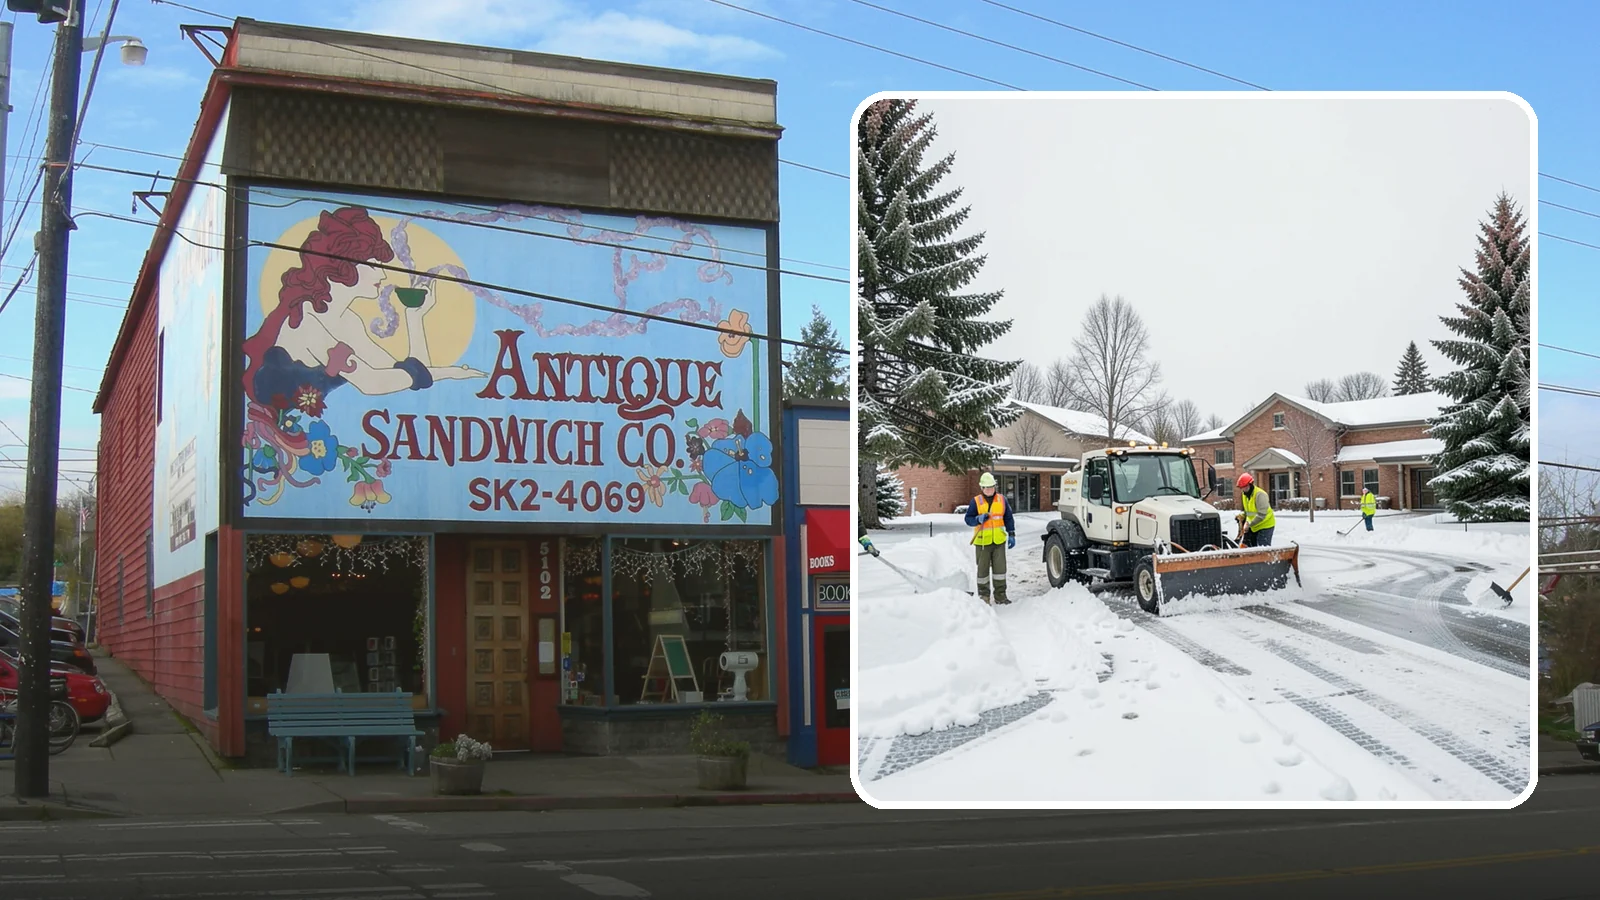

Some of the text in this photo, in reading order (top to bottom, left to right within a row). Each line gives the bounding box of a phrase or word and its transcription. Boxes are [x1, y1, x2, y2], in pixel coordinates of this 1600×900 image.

[476, 329, 724, 421] ANTIQUE
[361, 408, 685, 469] SANDWICH CO.
[468, 477, 646, 513] SK2-4069
[540, 542, 551, 599] 5102
[810, 555, 834, 569] BOOKS
